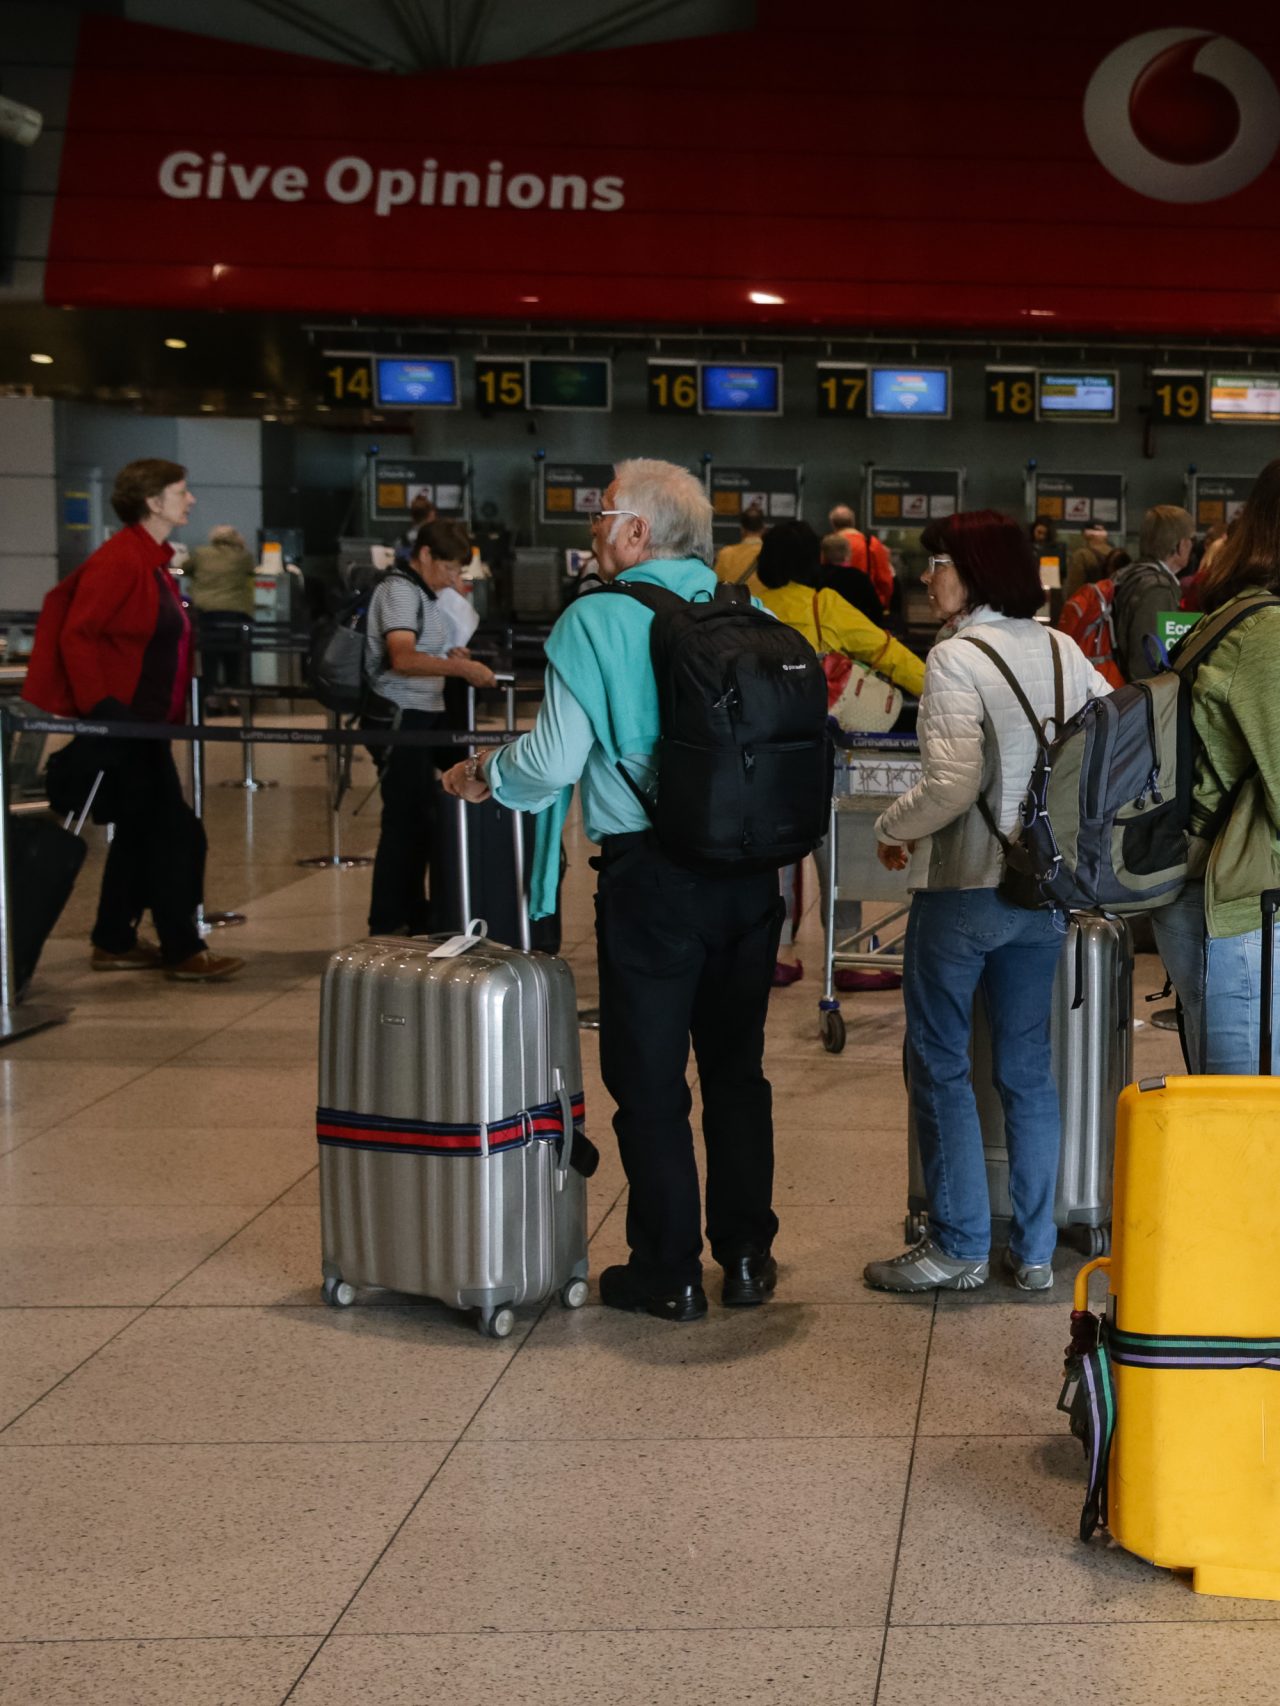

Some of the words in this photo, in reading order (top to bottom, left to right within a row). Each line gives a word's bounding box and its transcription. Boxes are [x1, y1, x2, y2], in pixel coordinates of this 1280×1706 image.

[157, 150, 310, 203] Give
[323, 156, 626, 217] Opinions
[328, 367, 370, 400] 14
[479, 371, 523, 405] 15
[652, 374, 697, 408] 16
[821, 377, 865, 410] 17
[990, 381, 1033, 414] 18
[1156, 385, 1200, 418] 19
[23, 719, 74, 732] Lufthansa
[75, 723, 109, 735] Group
[239, 730, 288, 740] Lufthansa
[290, 731, 323, 743] Group
[452, 733, 501, 744] Lufthansa
